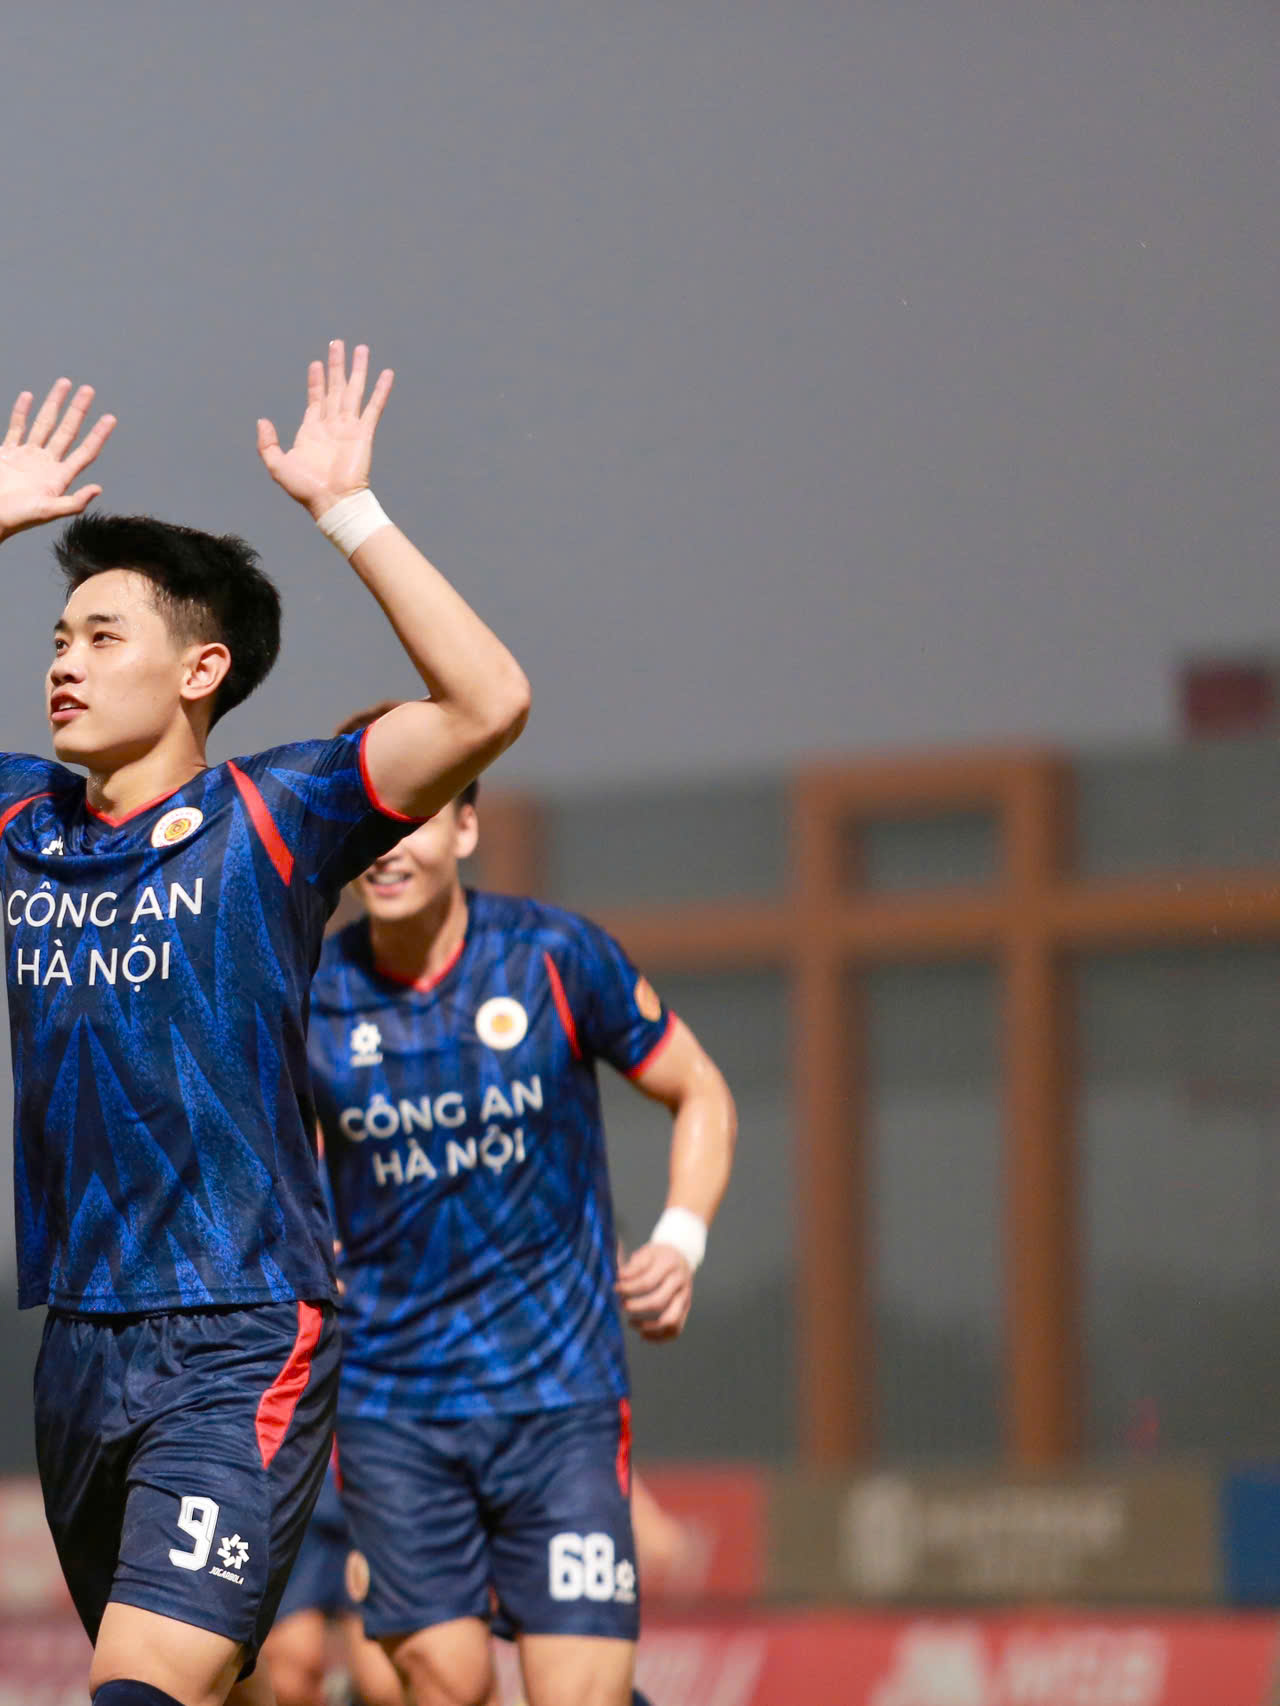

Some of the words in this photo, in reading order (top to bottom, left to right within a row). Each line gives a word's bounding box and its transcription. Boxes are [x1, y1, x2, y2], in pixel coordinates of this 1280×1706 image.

[7, 881, 118, 928] CÔNG
[130, 877, 203, 924] AN
[17, 938, 73, 986] HÀ
[88, 933, 170, 992] NỘI
[340, 1092, 466, 1142] CÔNG
[480, 1074, 543, 1123] AN
[372, 1139, 438, 1186] HÀ
[445, 1124, 526, 1176] NỘI
[168, 1495, 219, 1571] 9
[548, 1532, 614, 1601] 68
